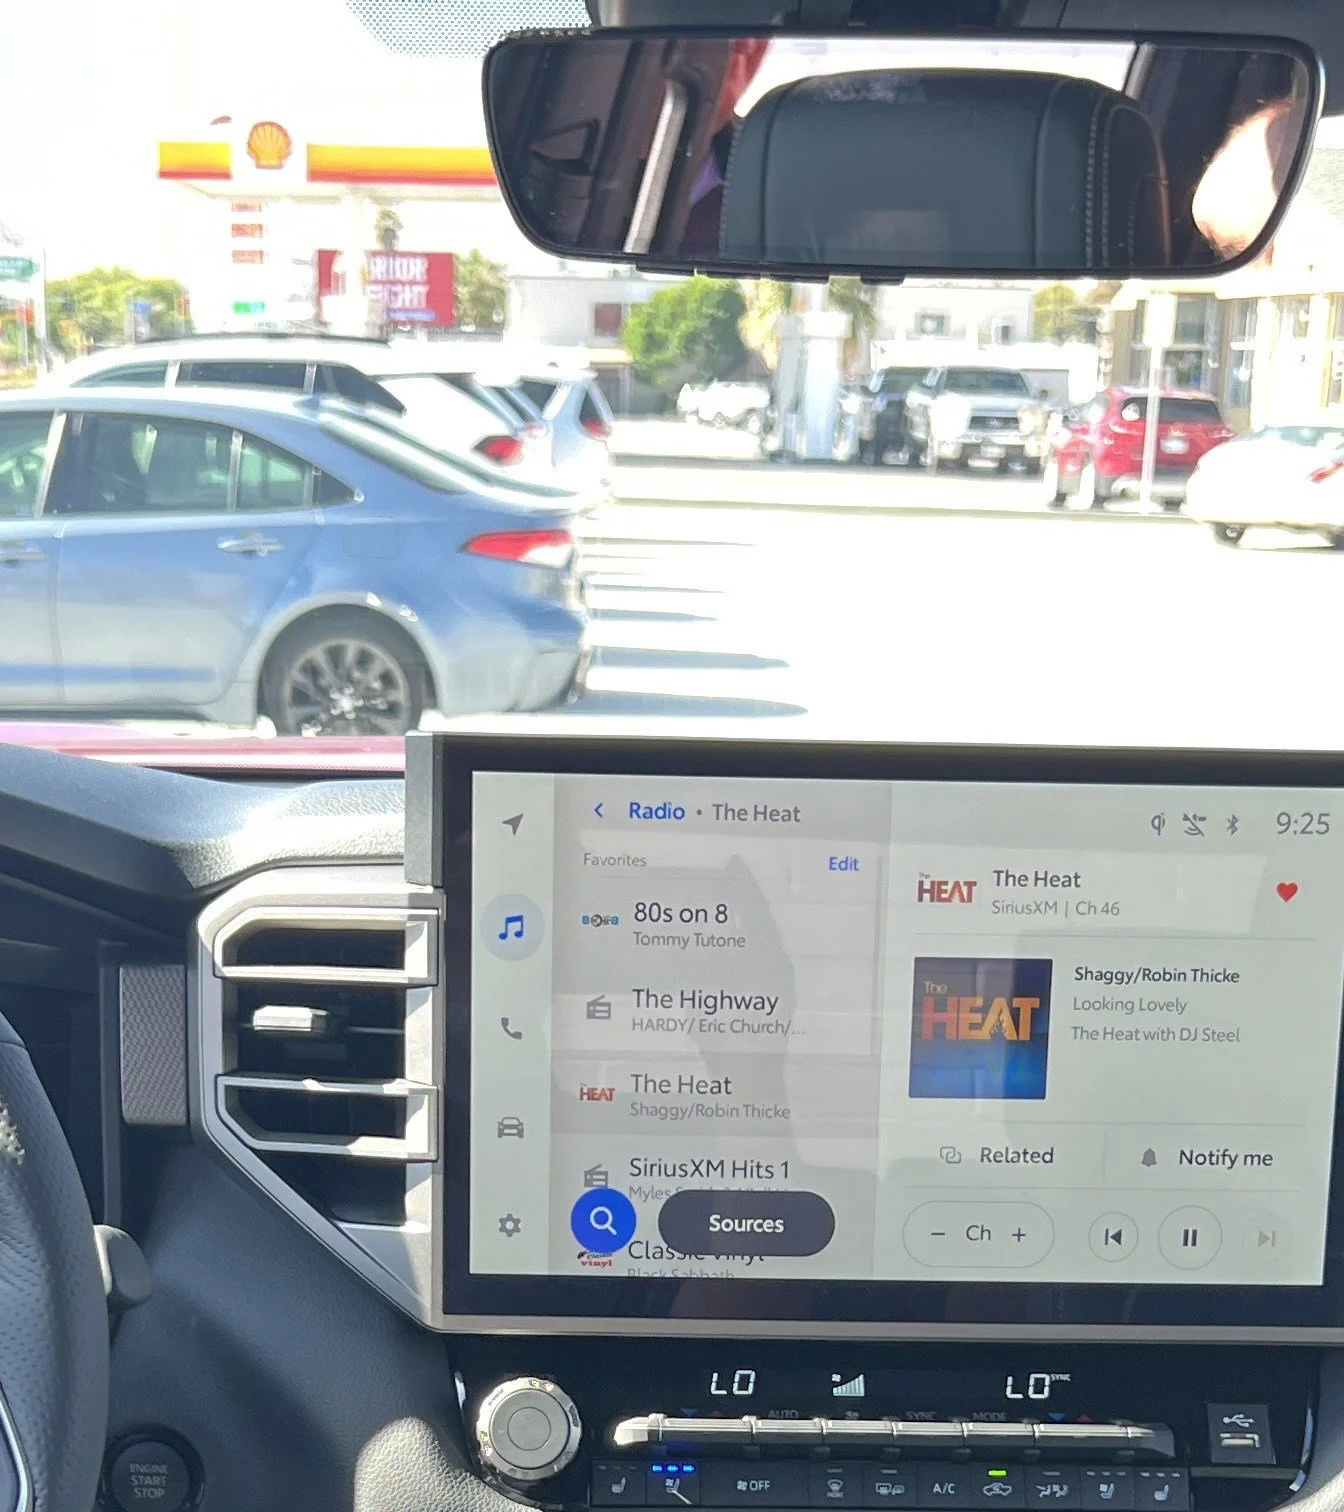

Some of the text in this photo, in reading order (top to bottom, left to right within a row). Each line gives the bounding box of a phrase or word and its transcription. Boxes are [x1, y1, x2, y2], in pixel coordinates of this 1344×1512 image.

[629, 802, 801, 822] Radio The Heat
[1276, 812, 1331, 835] 9:25
[583, 853, 647, 868] Favorites
[829, 857, 860, 871] Edit
[993, 870, 1081, 888] The Heat
[917, 880, 977, 903] HEAT
[634, 902, 673, 923] 80s
[679, 908, 707, 923] on
[715, 904, 729, 923] 8
[992, 900, 1120, 916] SiriusXM Ch 46
[633, 932, 746, 950] Tommy Tutone
[1074, 966, 1240, 985] Shaggy/Robin Thicke
[924, 981, 948, 994] The
[632, 989, 779, 1015] The Highway
[1073, 997, 1187, 1015] Looking Lovely
[632, 1018, 695, 1034] HARDY/
[699, 1019, 726, 1034] Eric
[922, 996, 1040, 1041] HEAT
[1071, 1026, 1241, 1043] The Heat with DJ Steel
[630, 1074, 733, 1095] The Heat
[579, 1087, 616, 1102] HEAT
[630, 1102, 791, 1121] Shaggy/Robin Thicke
[980, 1147, 1054, 1165] Related
[1178, 1149, 1274, 1170] Notify me
[629, 1158, 790, 1179] SiriusXM Hits 1
[629, 1186, 671, 1203] Myles
[708, 1215, 785, 1233] Sources
[965, 1225, 991, 1241] Ch
[710, 1369, 757, 1396] LO
[1005, 1373, 1051, 1399] LO
[768, 1409, 799, 1420] AUTO
[906, 1411, 937, 1421] SYNC
[973, 1411, 1006, 1421] MODE
[130, 1474, 167, 1487] START
[749, 1479, 771, 1492] OFF
[932, 1482, 956, 1495] A/C
[134, 1487, 165, 1499] STOP
